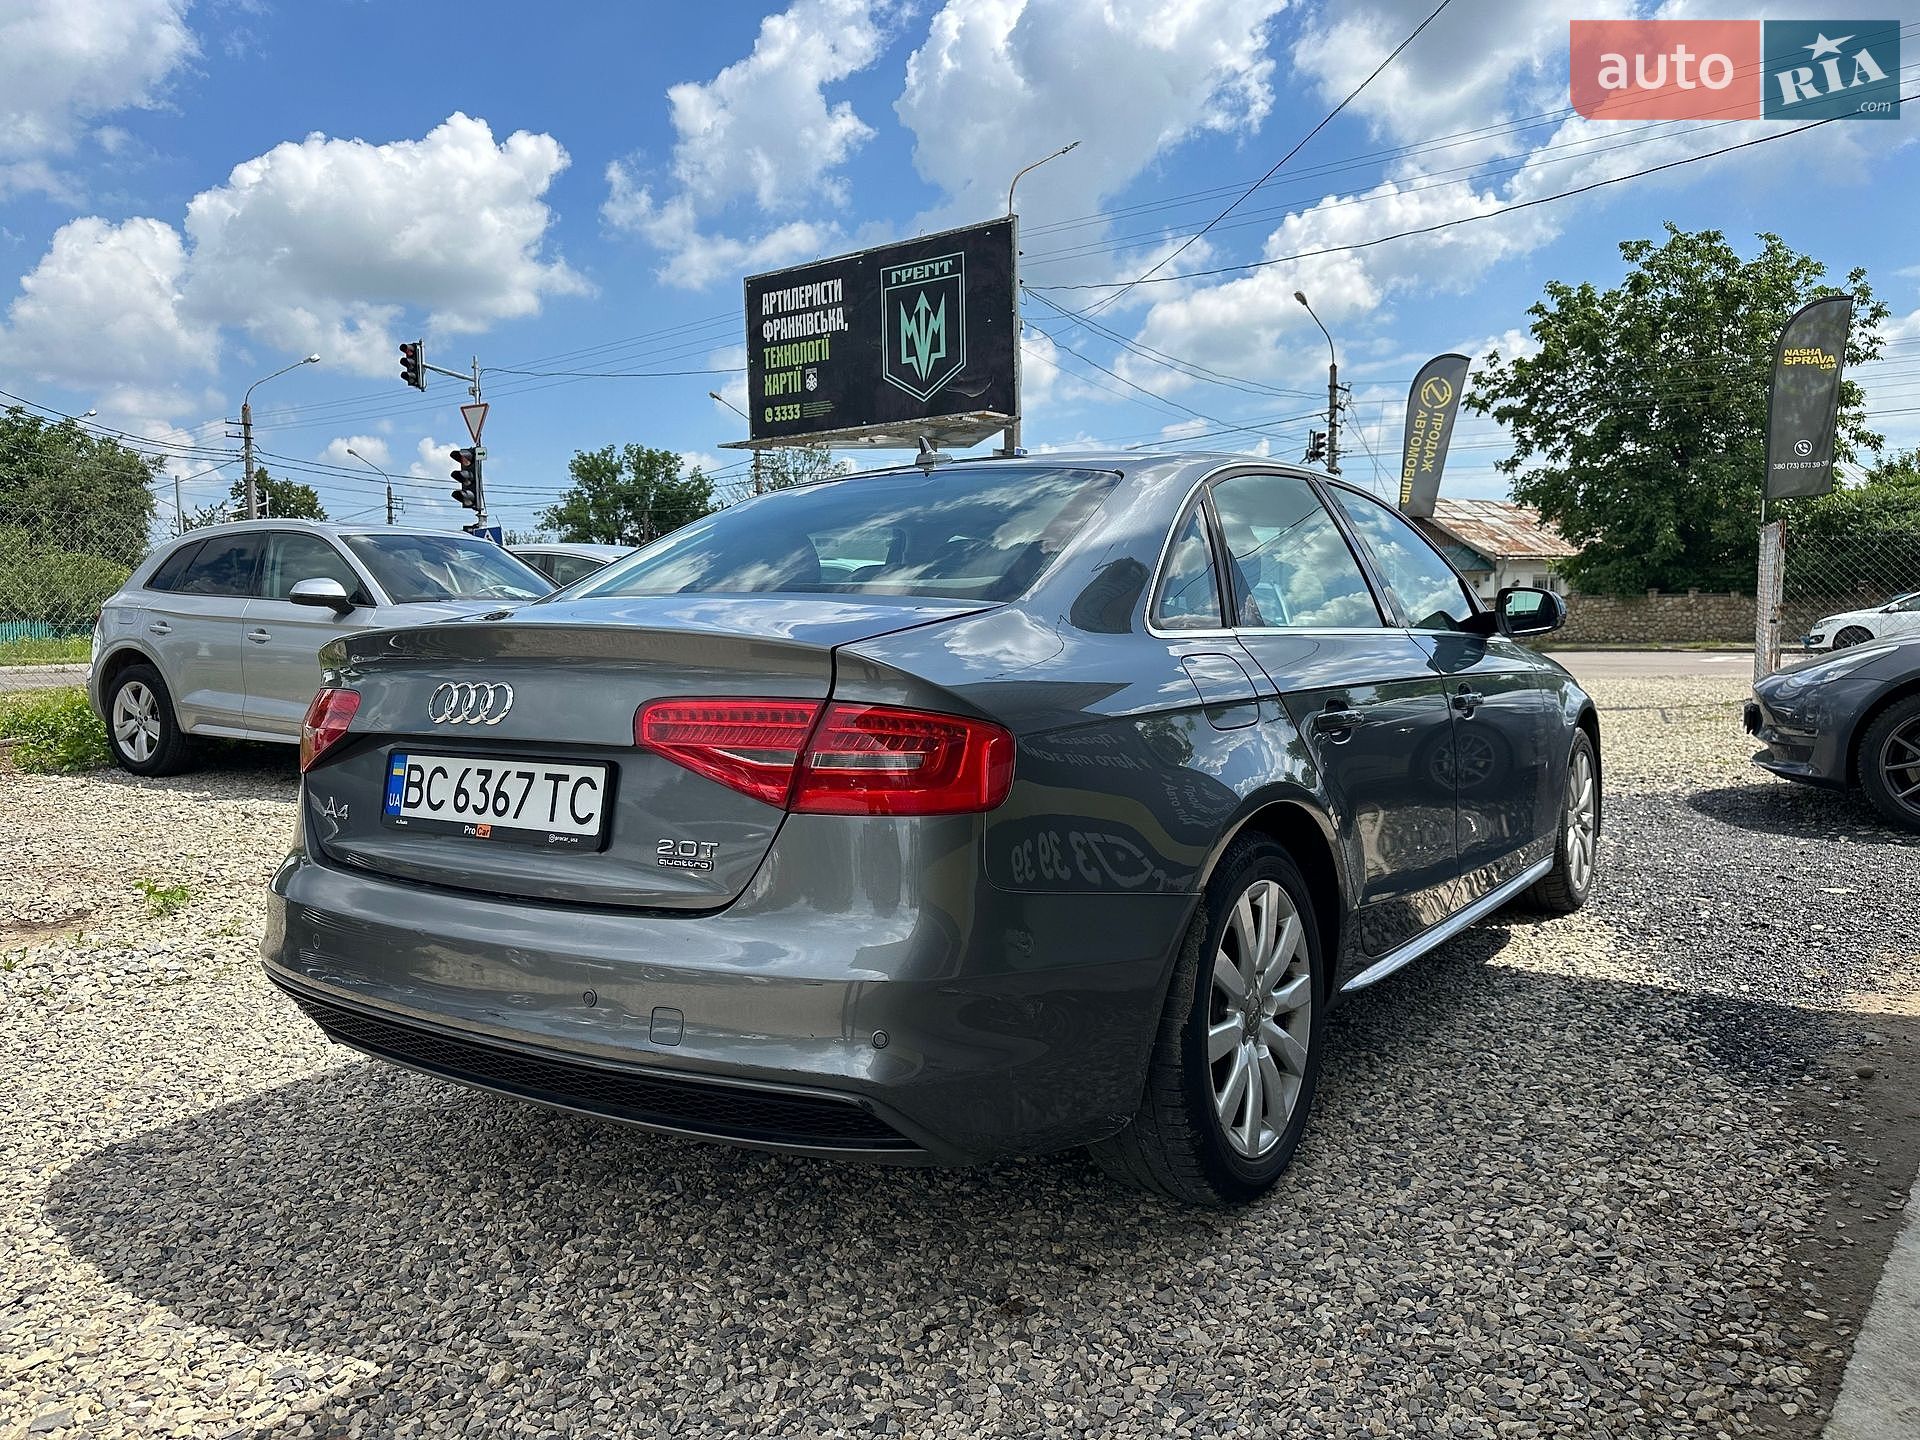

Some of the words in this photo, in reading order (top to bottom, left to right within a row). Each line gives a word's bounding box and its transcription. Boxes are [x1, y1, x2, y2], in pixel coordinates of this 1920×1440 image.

[761, 277, 843, 316] АРТИЛЕРИСТИ
[762, 306, 849, 343] ФРАНКІВСЬКА,
[763, 332, 831, 370] ТЕХНОЛОГІЇ
[1783, 355, 1836, 366] SPRAVA
[1784, 348, 1822, 356] NASHA
[1819, 362, 1838, 370] USA
[764, 365, 803, 397] ХАРТІЇ
[774, 403, 801, 422] 3333
[1420, 412, 1445, 473] ПРОДАЖ
[388, 793, 401, 808] UA
[403, 763, 449, 812] BC
[453, 767, 536, 820] 6367
[544, 772, 598, 826] TC
[323, 796, 349, 821] A4
[658, 859, 709, 869] quattro
